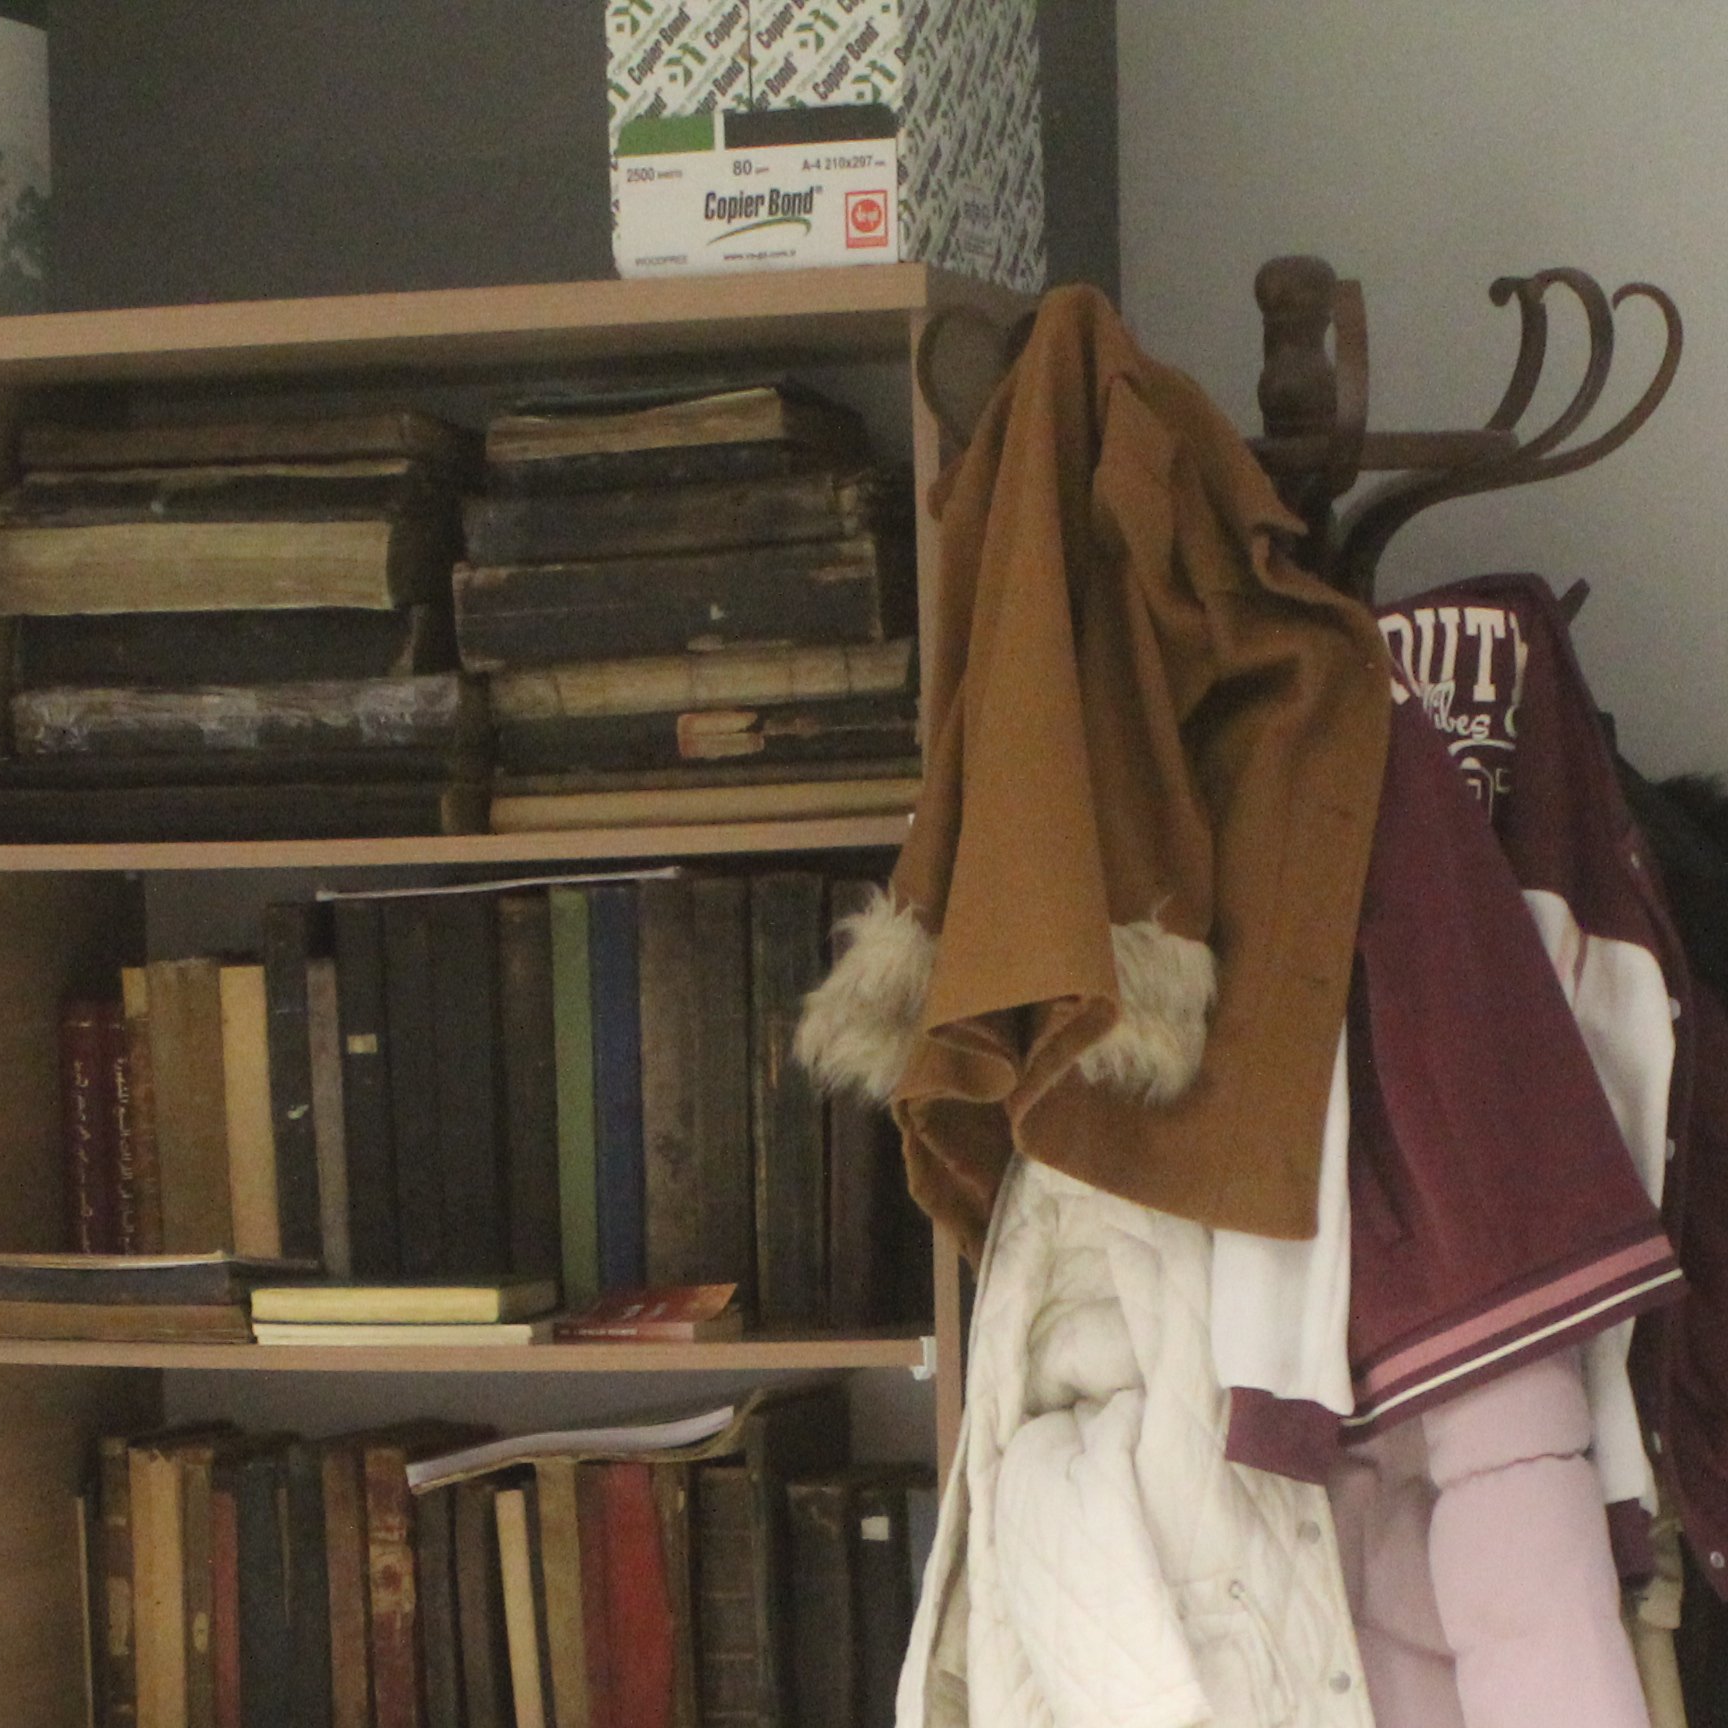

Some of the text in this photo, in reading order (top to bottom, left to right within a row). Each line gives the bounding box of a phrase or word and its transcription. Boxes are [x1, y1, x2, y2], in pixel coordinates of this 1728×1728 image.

[628, 7, 692, 86] Copier Bond
[845, 21, 879, 61] Bond
[626, 167, 655, 182] 2500
[732, 159, 752, 177] 80
[704, 185, 815, 223] Copier Bond
